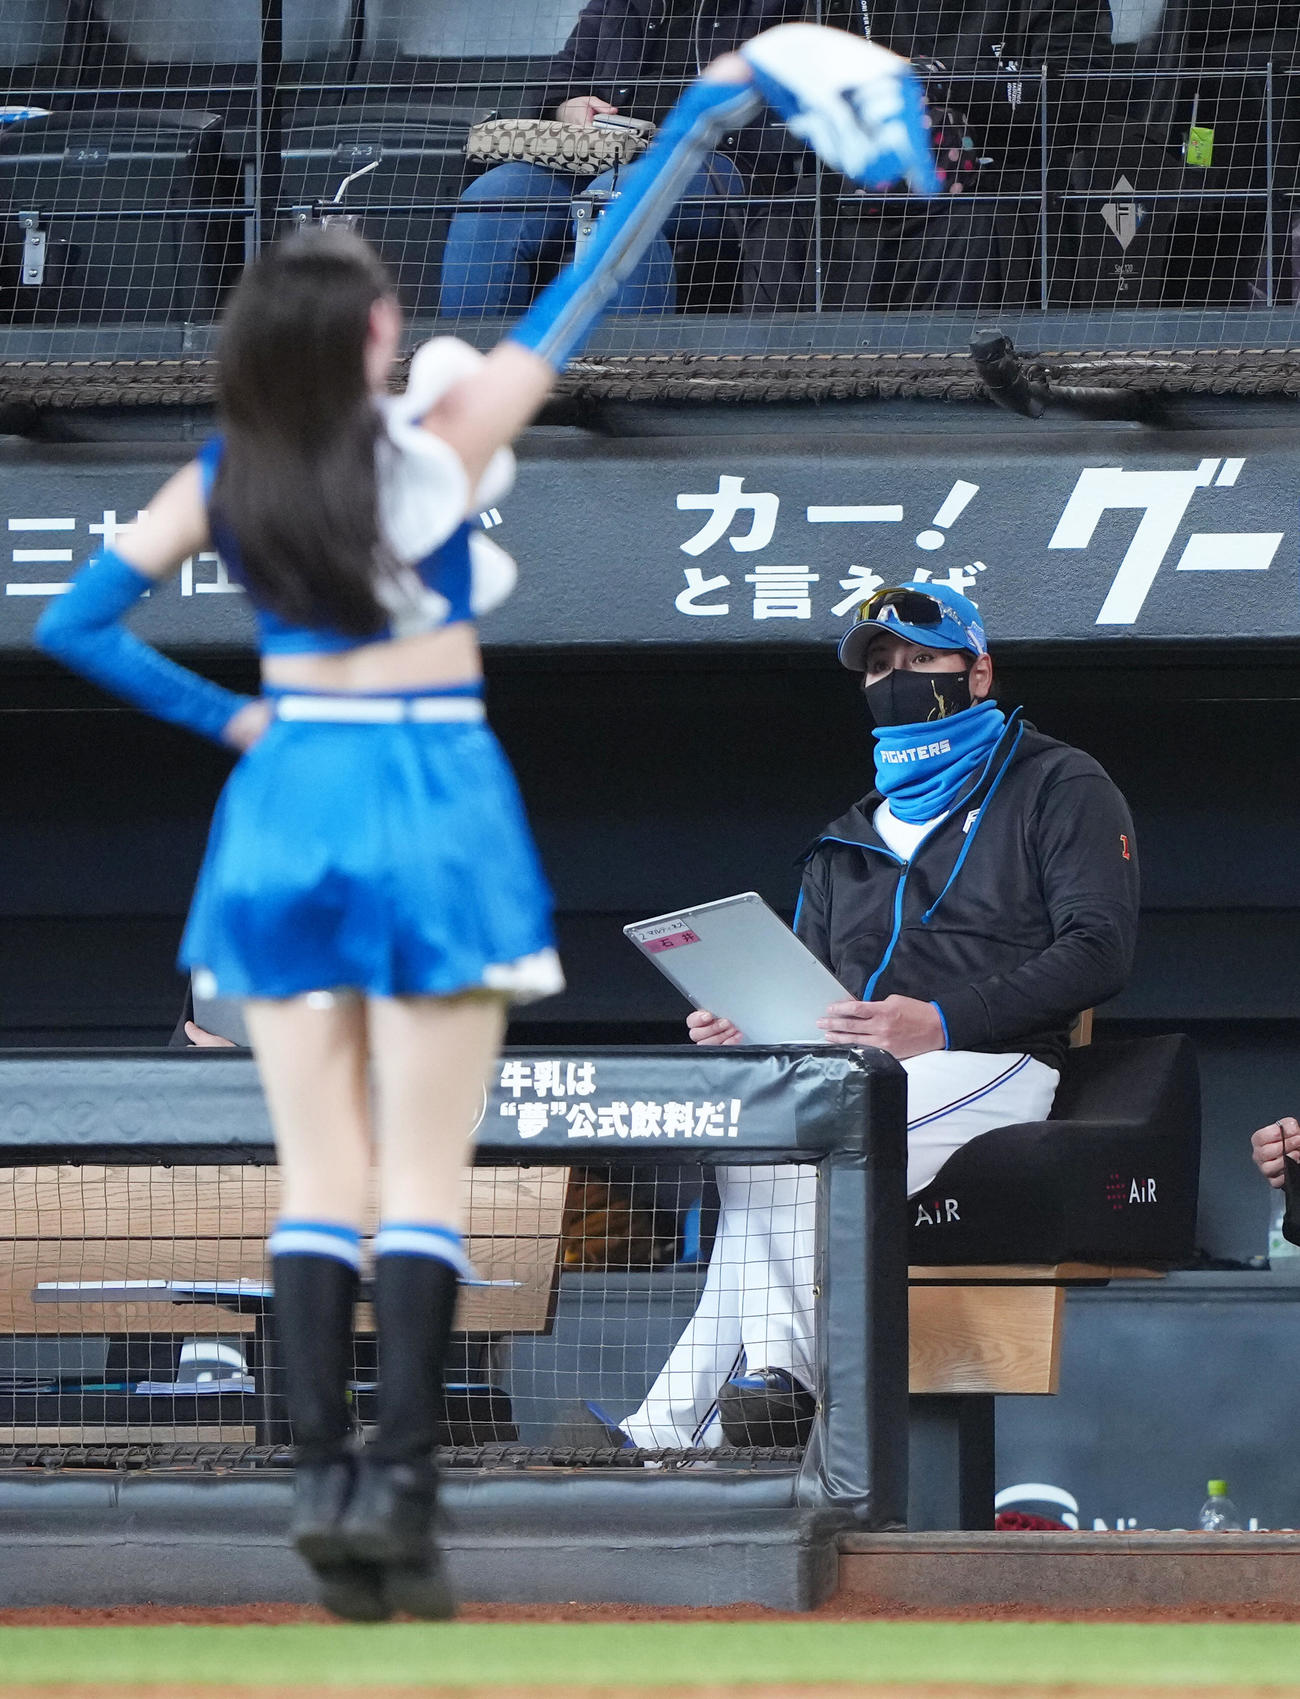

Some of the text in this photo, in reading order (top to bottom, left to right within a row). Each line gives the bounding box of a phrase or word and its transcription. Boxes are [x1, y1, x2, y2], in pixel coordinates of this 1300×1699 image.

[1047, 457, 1285, 625] グー
[880, 739, 951, 763] FIGHTERS
[1119, 834, 1130, 861] 1
[500, 1060, 597, 1098] 牛乳は
